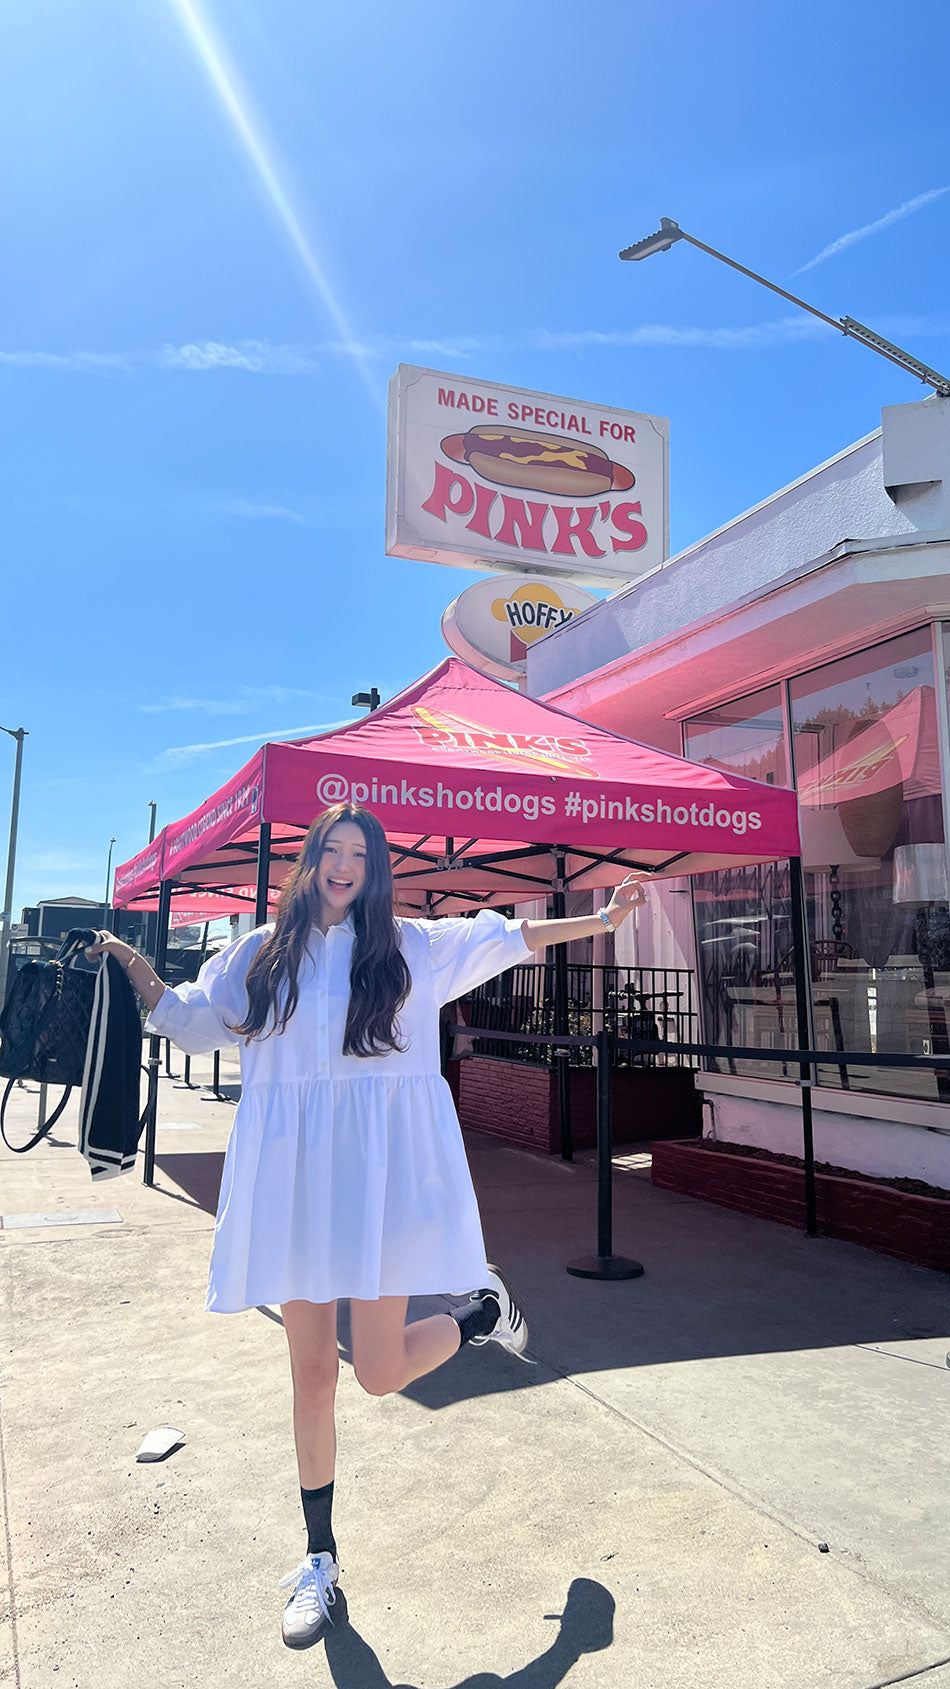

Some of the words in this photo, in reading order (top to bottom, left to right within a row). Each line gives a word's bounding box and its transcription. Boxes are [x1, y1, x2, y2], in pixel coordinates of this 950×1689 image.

[437, 388, 498, 417] MADE
[507, 402, 592, 435] SPECIAL
[599, 420, 636, 443] FOR
[421, 460, 648, 558] PINK'S
[506, 602, 573, 629] HOFFY
[413, 725, 592, 756] PINK'S
[316, 773, 556, 821] @pinkshotdogs
[564, 791, 762, 835] #pinkshotdogs
